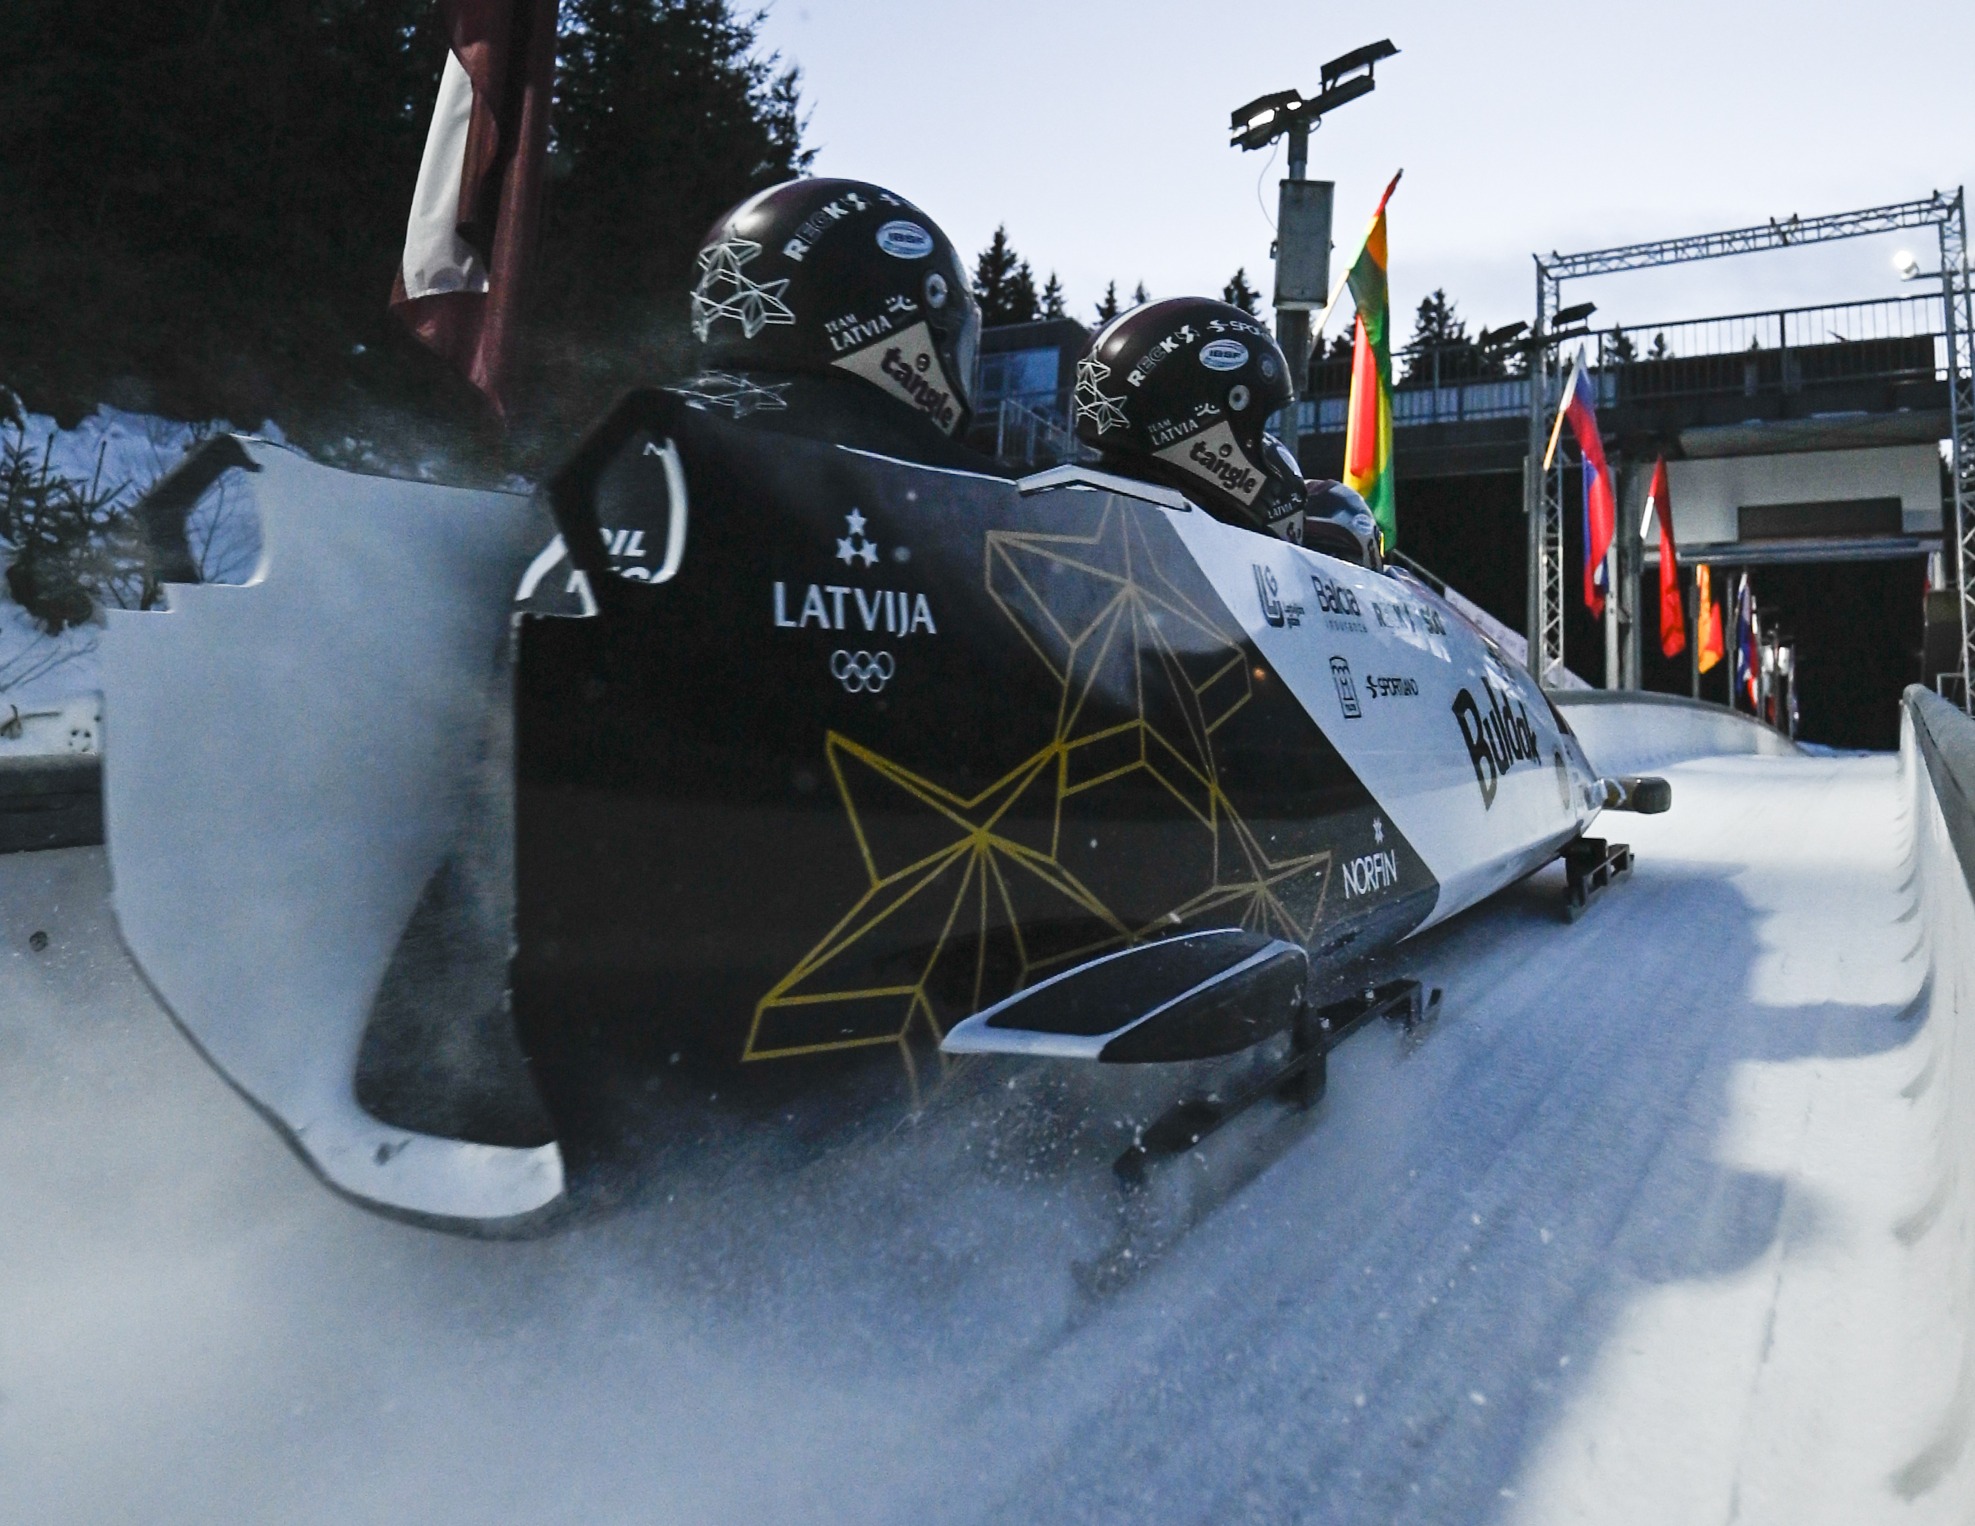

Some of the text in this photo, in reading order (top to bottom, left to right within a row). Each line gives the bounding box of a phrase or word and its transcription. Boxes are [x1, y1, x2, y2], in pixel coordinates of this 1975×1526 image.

[830, 315, 893, 351] LATVIA
[1208, 349, 1242, 359] IBSF
[881, 347, 954, 429] tangle
[1152, 419, 1199, 446] LATVIA
[1190, 441, 1257, 494] tangle
[773, 581, 938, 639] LATVIJA
[1342, 849, 1397, 899] NORFIN
